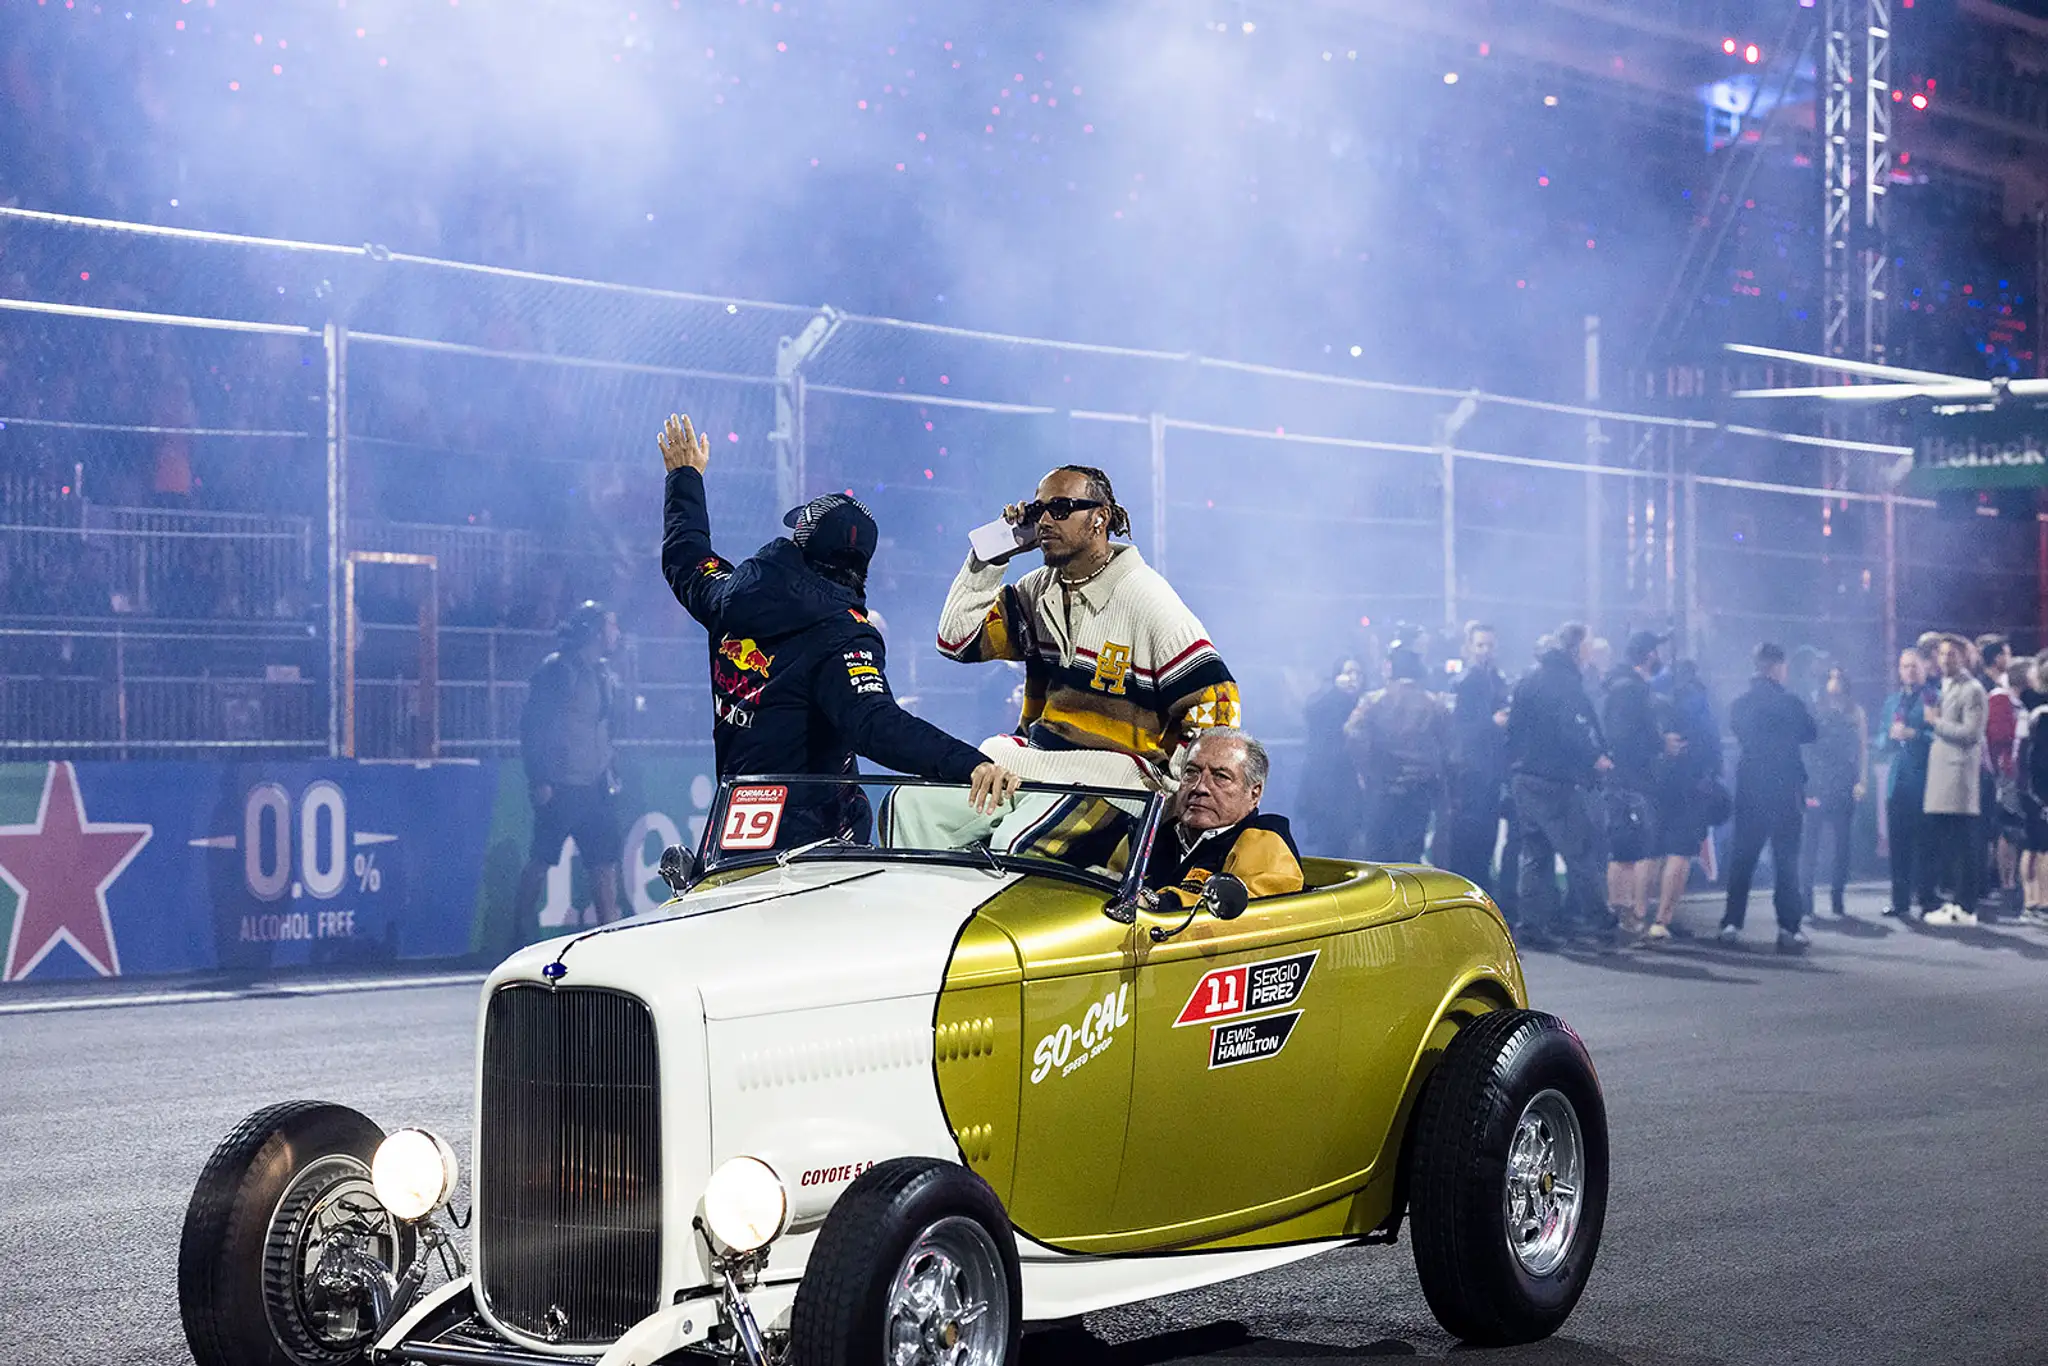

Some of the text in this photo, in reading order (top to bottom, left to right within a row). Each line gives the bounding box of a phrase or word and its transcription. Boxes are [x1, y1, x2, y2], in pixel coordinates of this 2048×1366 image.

[1921, 436, 2048, 468] Heinek
[737, 675, 766, 705] Bll
[736, 789, 784, 797] FORMULA 1
[726, 811, 774, 840] 19
[239, 909, 356, 942] ALCOHOL FREE
[1253, 962, 1300, 988] SERGIO
[1204, 975, 1239, 1014] 11
[1251, 981, 1294, 1005] PEREZ
[1030, 982, 1129, 1085] SO-CAL
[1219, 1025, 1257, 1046] LEWIS
[1217, 1035, 1279, 1060] HAMILTON
[801, 1164, 852, 1187] COYOTE
